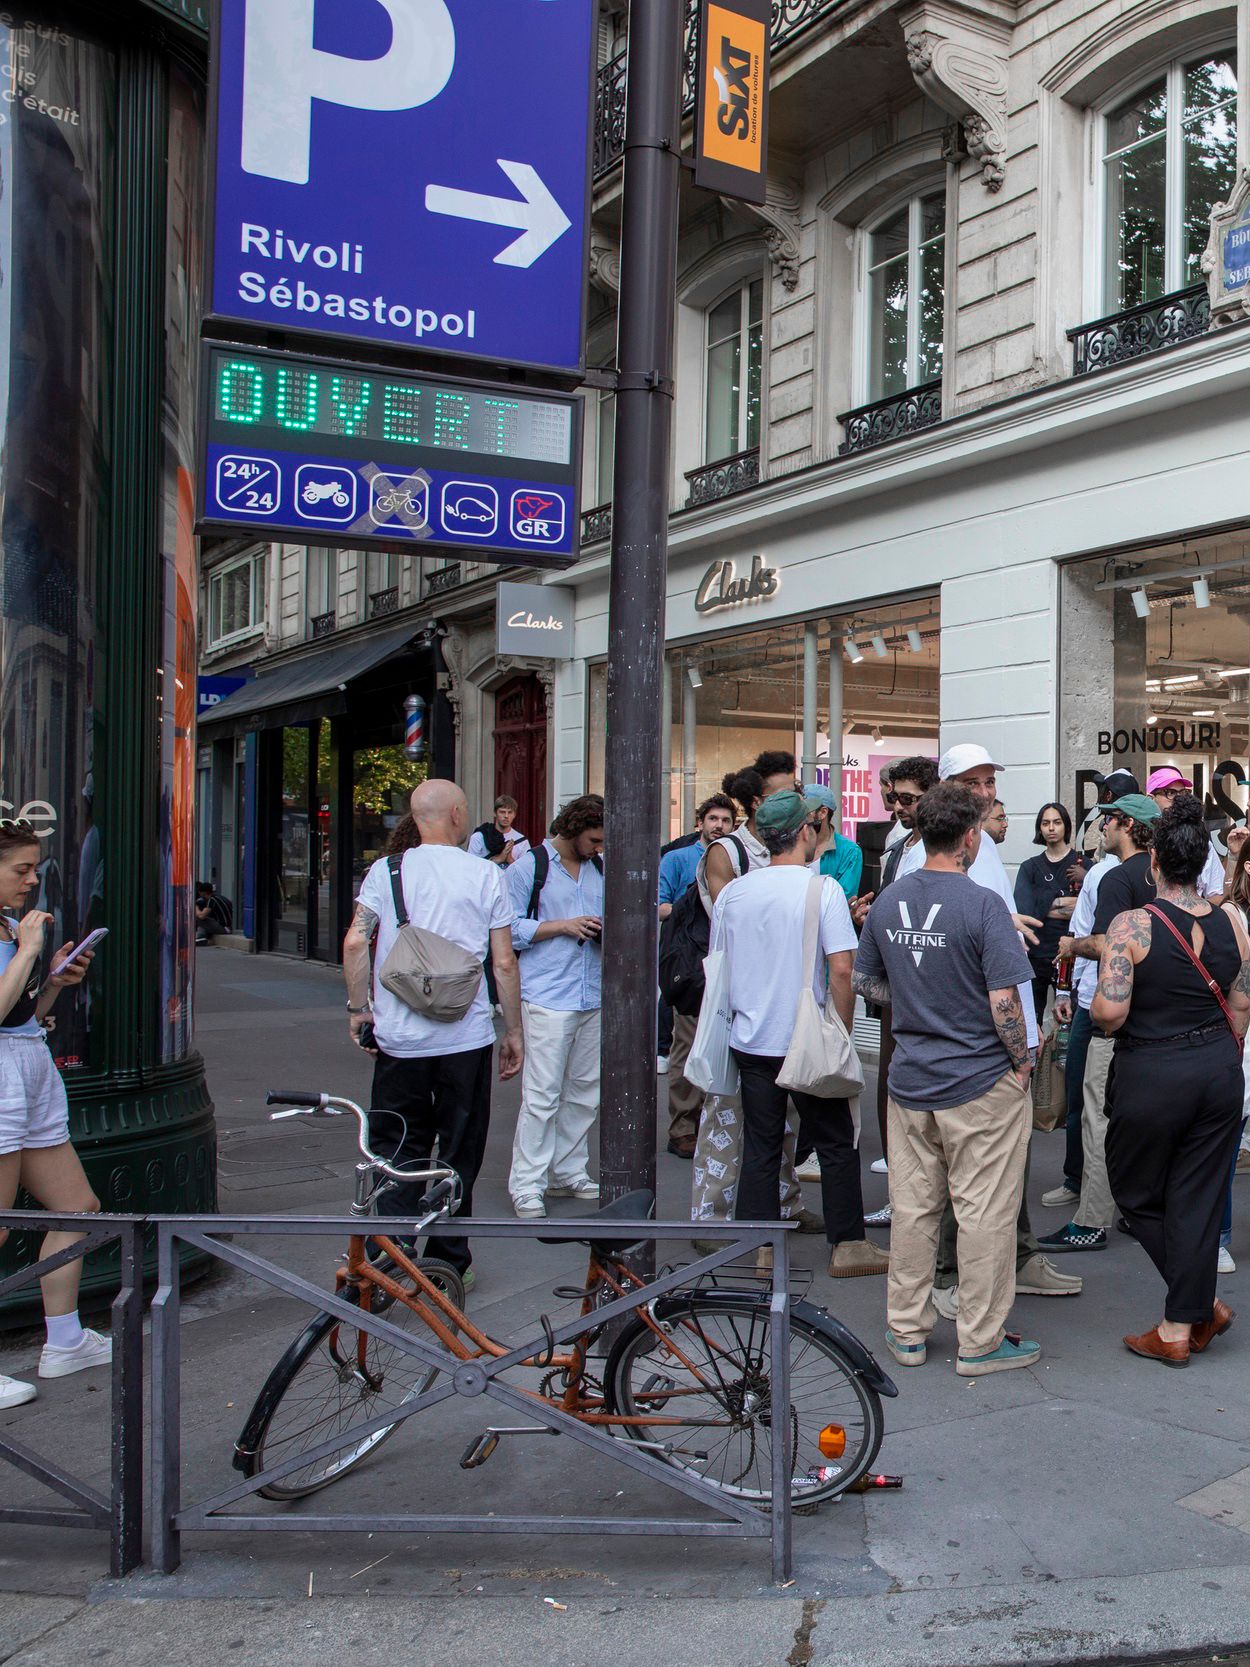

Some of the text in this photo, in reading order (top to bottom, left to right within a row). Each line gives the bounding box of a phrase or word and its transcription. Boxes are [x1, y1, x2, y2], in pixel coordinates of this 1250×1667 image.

[23, 20, 73, 46] suis
[241, 0, 456, 185] P
[751, 93, 758, 105] de
[750, 105, 758, 144] location
[241, 222, 363, 274] Rivoli
[238, 271, 476, 338] Sébastopol
[221, 362, 519, 454] OUVERT
[516, 519, 550, 537] GR
[695, 555, 779, 613] Clarks
[507, 611, 563, 630] Clarks
[1097, 723, 1222, 755] BONJOUR!
[886, 929, 947, 948] VITRINE
